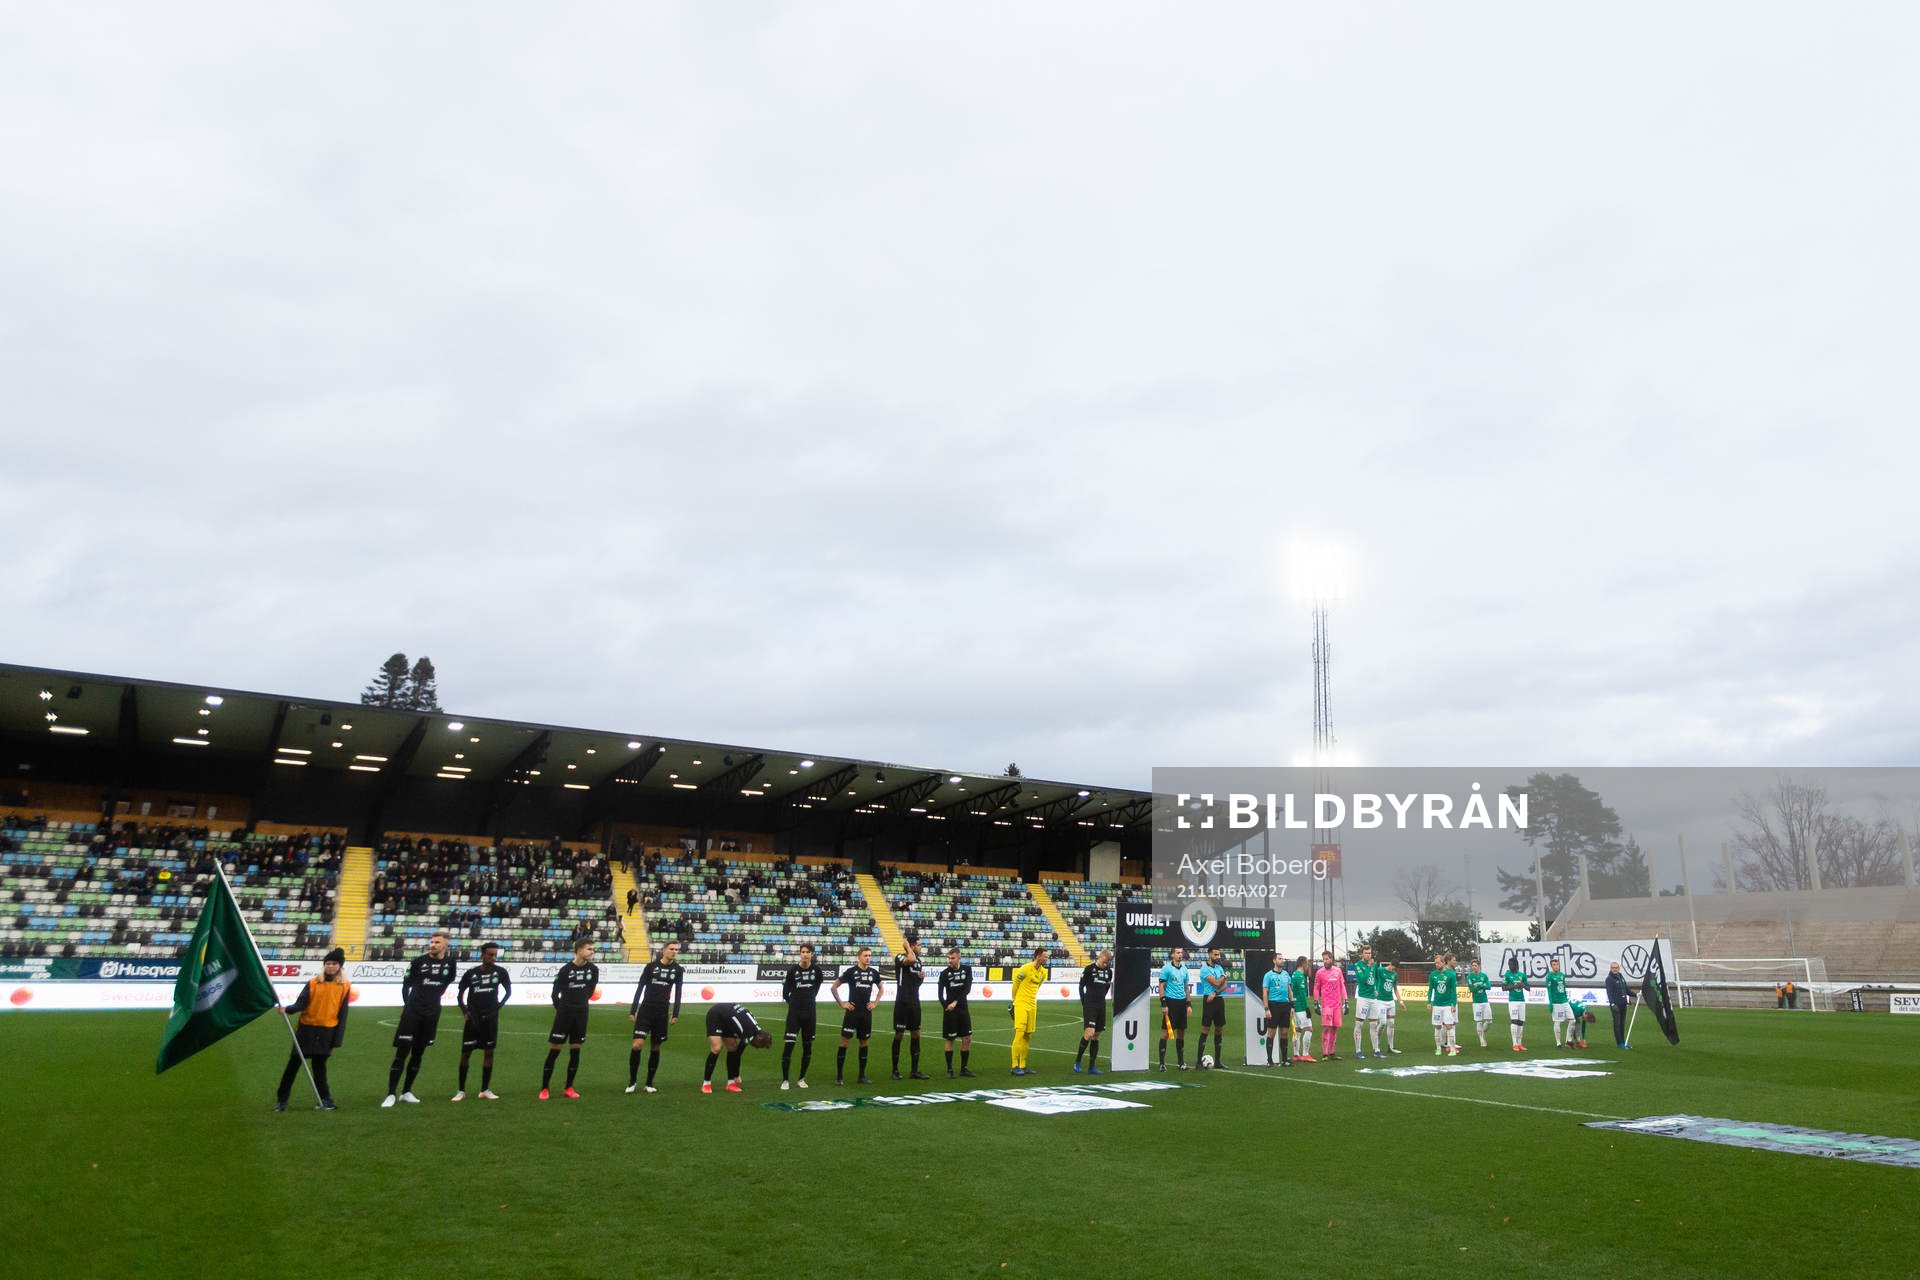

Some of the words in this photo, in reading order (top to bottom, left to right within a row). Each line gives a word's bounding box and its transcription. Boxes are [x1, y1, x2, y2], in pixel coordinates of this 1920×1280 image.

[1125, 912, 1172, 927] UNIBET
[1226, 916, 1268, 930] UNIBET
[1499, 944, 1597, 979] Atteviks
[118, 963, 182, 978] Husqvar
[1125, 1020, 1138, 1041] U
